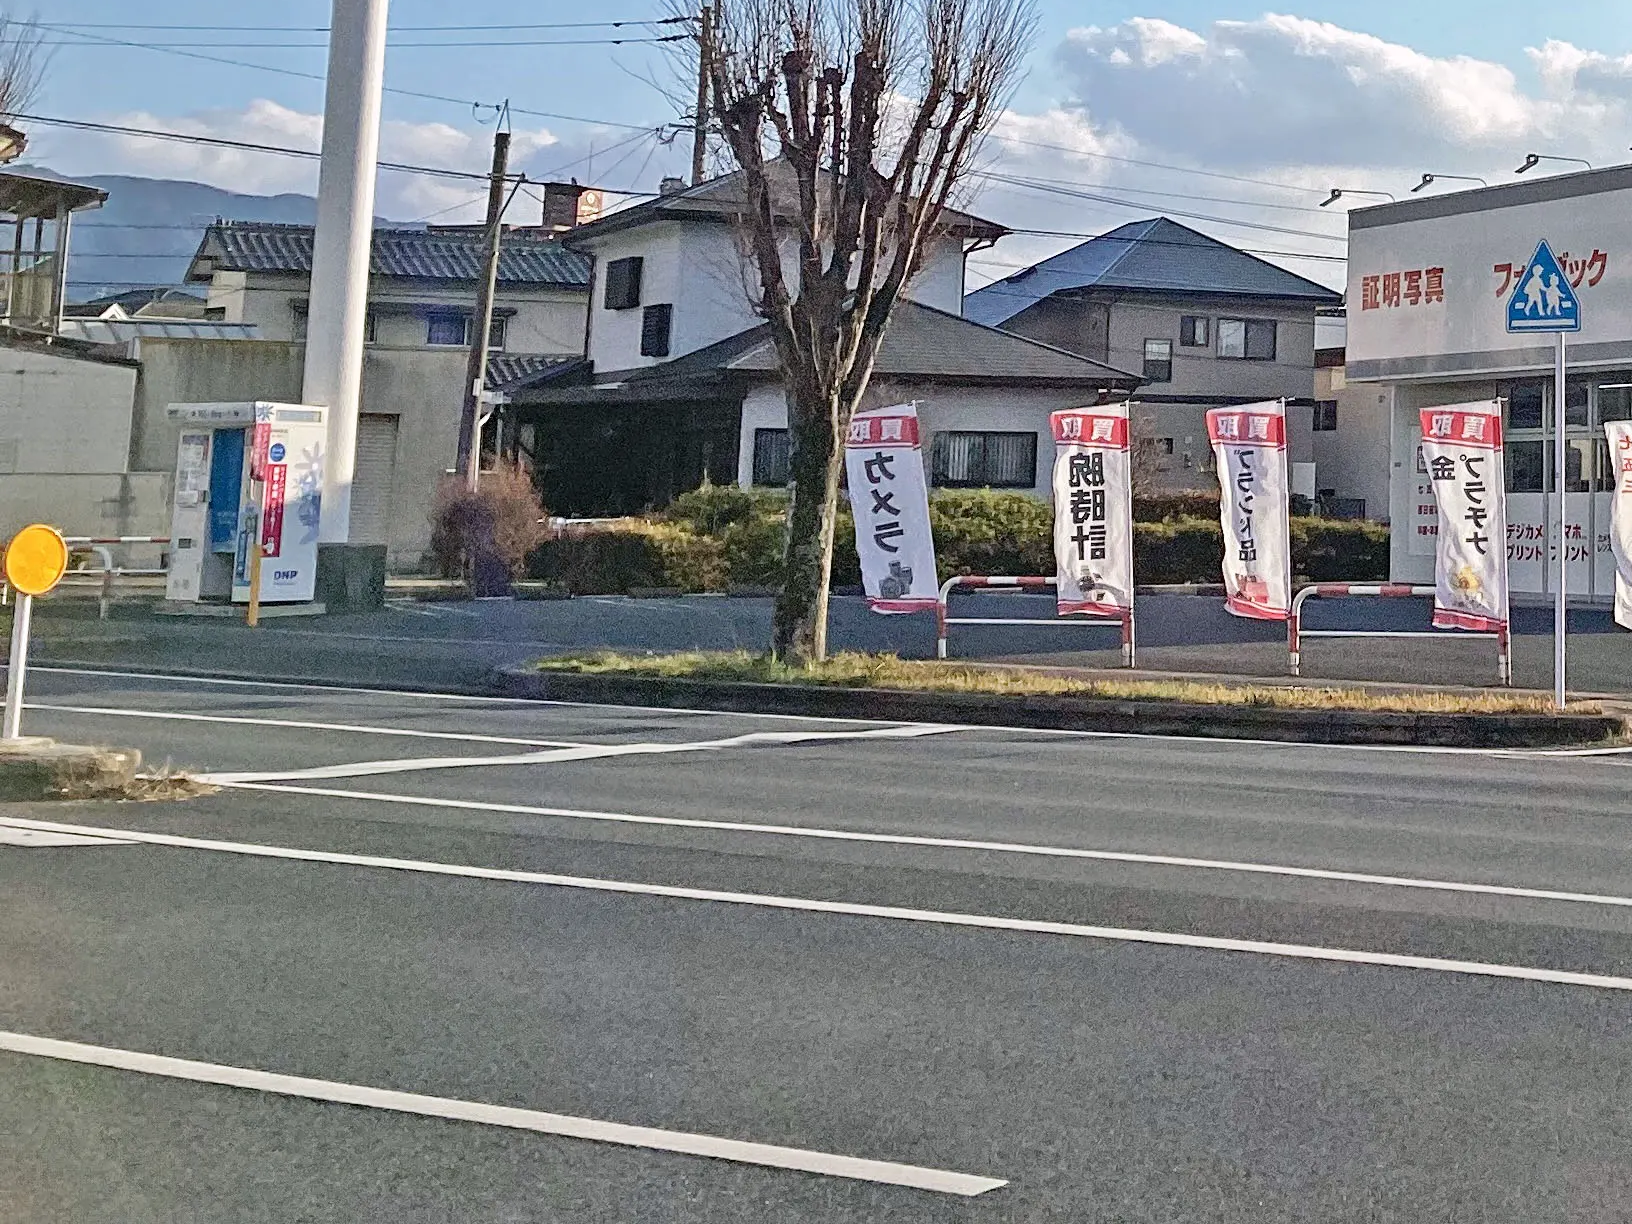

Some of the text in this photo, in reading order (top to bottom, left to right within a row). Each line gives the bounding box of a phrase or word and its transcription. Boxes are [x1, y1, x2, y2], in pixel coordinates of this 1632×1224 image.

[1361, 266, 1445, 311] 証明写真
[1494, 249, 1608, 298] フック
[1507, 523, 1543, 540] デジカメ
[1507, 543, 1543, 562] プリント
